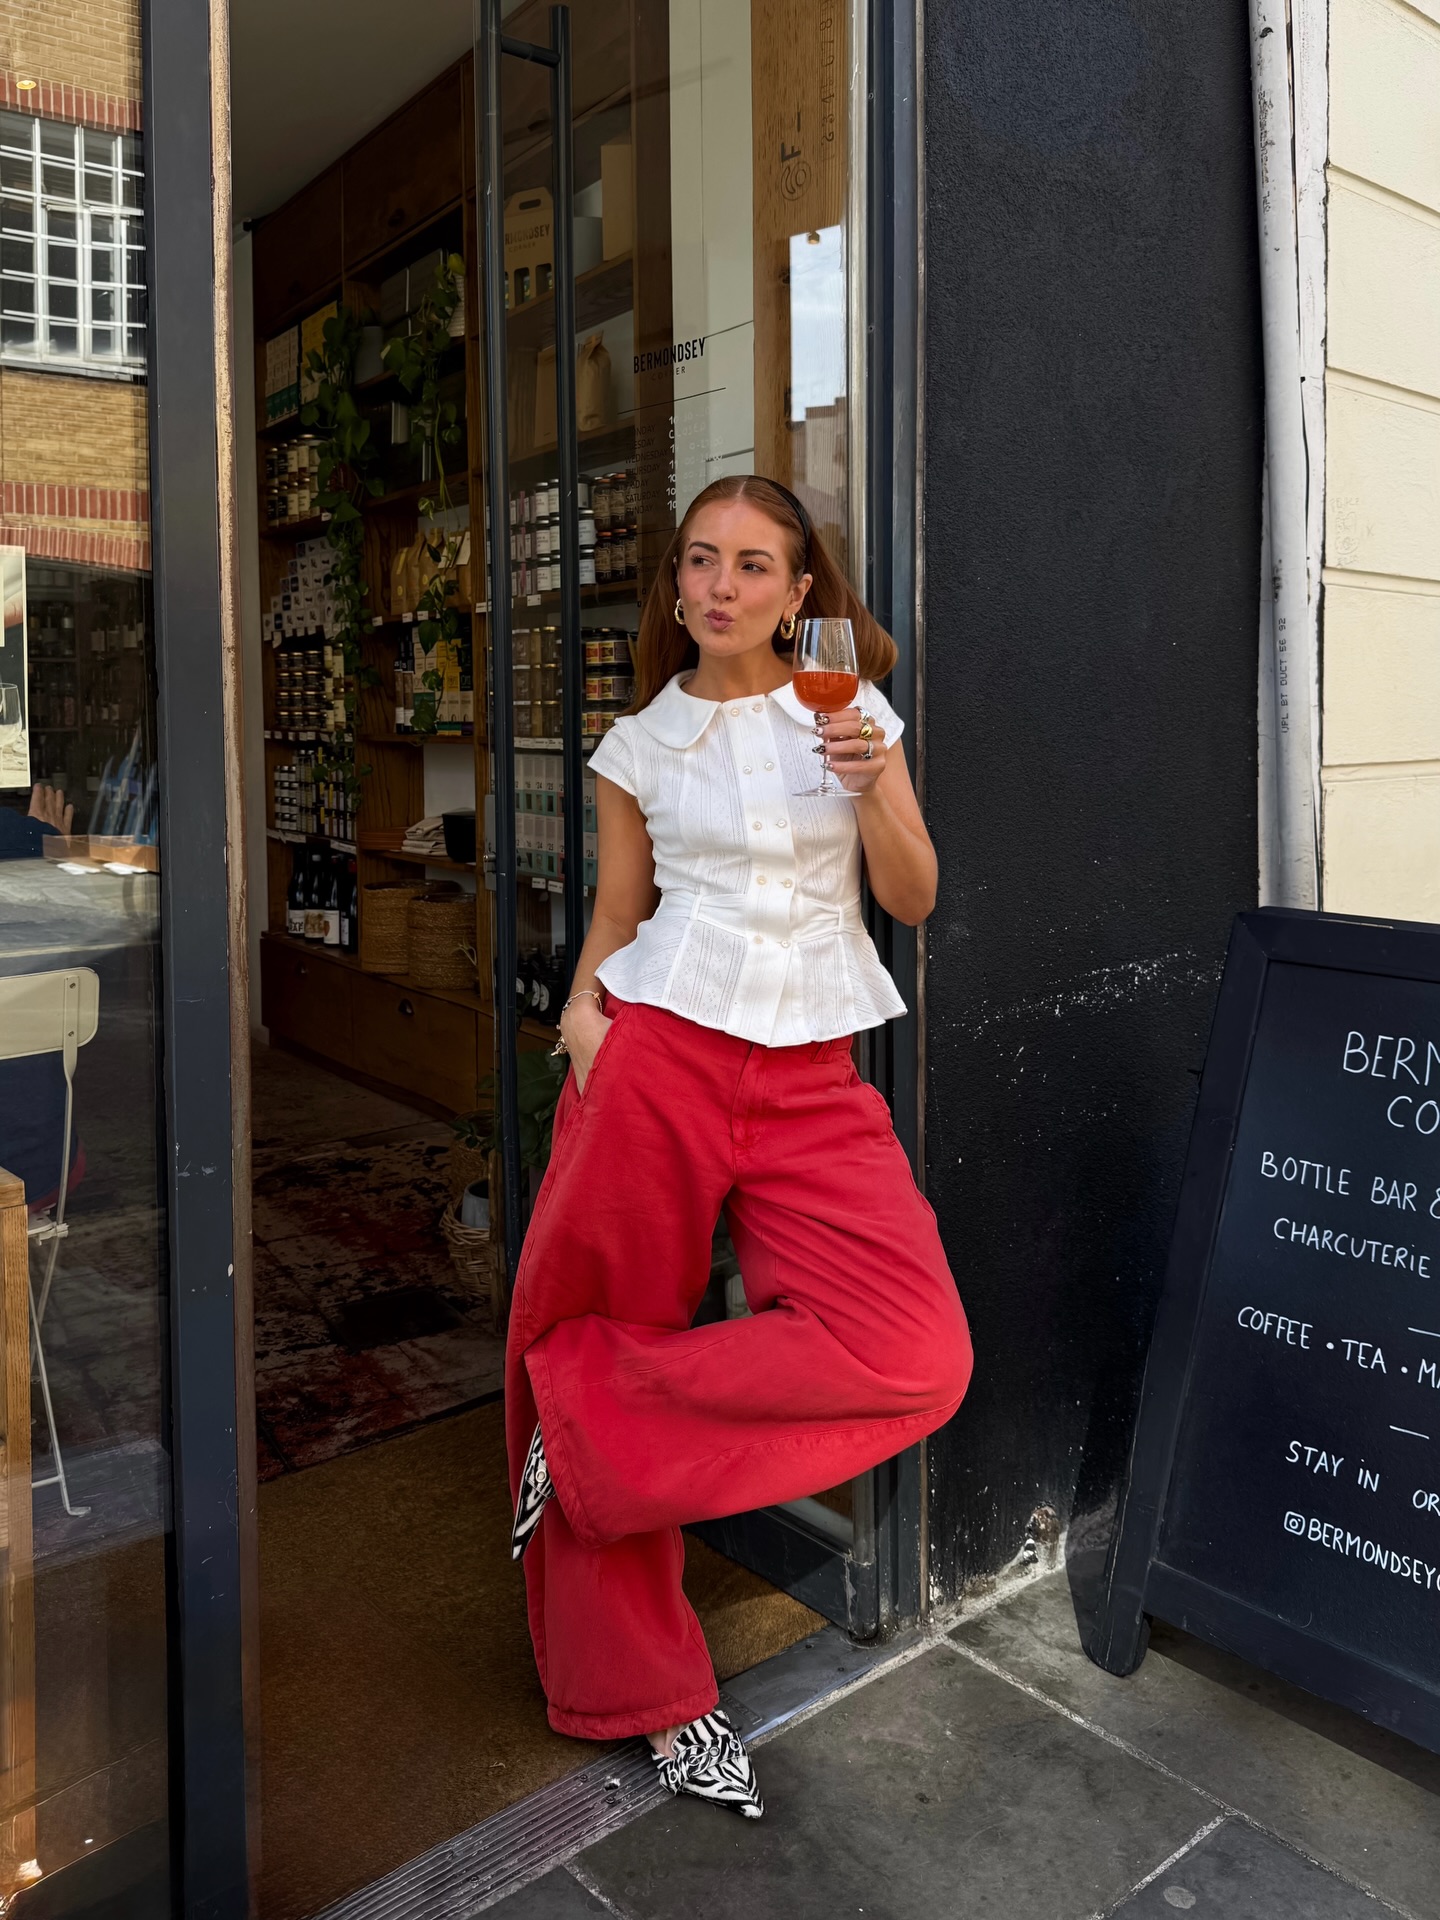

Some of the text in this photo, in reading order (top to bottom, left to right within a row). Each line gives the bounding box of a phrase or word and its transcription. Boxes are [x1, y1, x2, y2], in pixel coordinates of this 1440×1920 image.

[505, 223, 550, 245] RMONDSEY
[633, 337, 706, 374] BERMONDSEY
[650, 365, 686, 381] COER
[625, 449, 668, 464] WEDNESDAY
[625, 490, 660, 503] SATURDAY
[1278, 618, 1286, 631] 92
[1279, 659, 1288, 686] DUCT
[1387, 1095, 1440, 1135] CO
[1261, 1151, 1352, 1196] BOTTLE
[1370, 1176, 1417, 1212] BAR
[1237, 1306, 1440, 1389] COFFEE TEA M
[1285, 1440, 1345, 1477] STAY
[1412, 1489, 1440, 1517] OR
